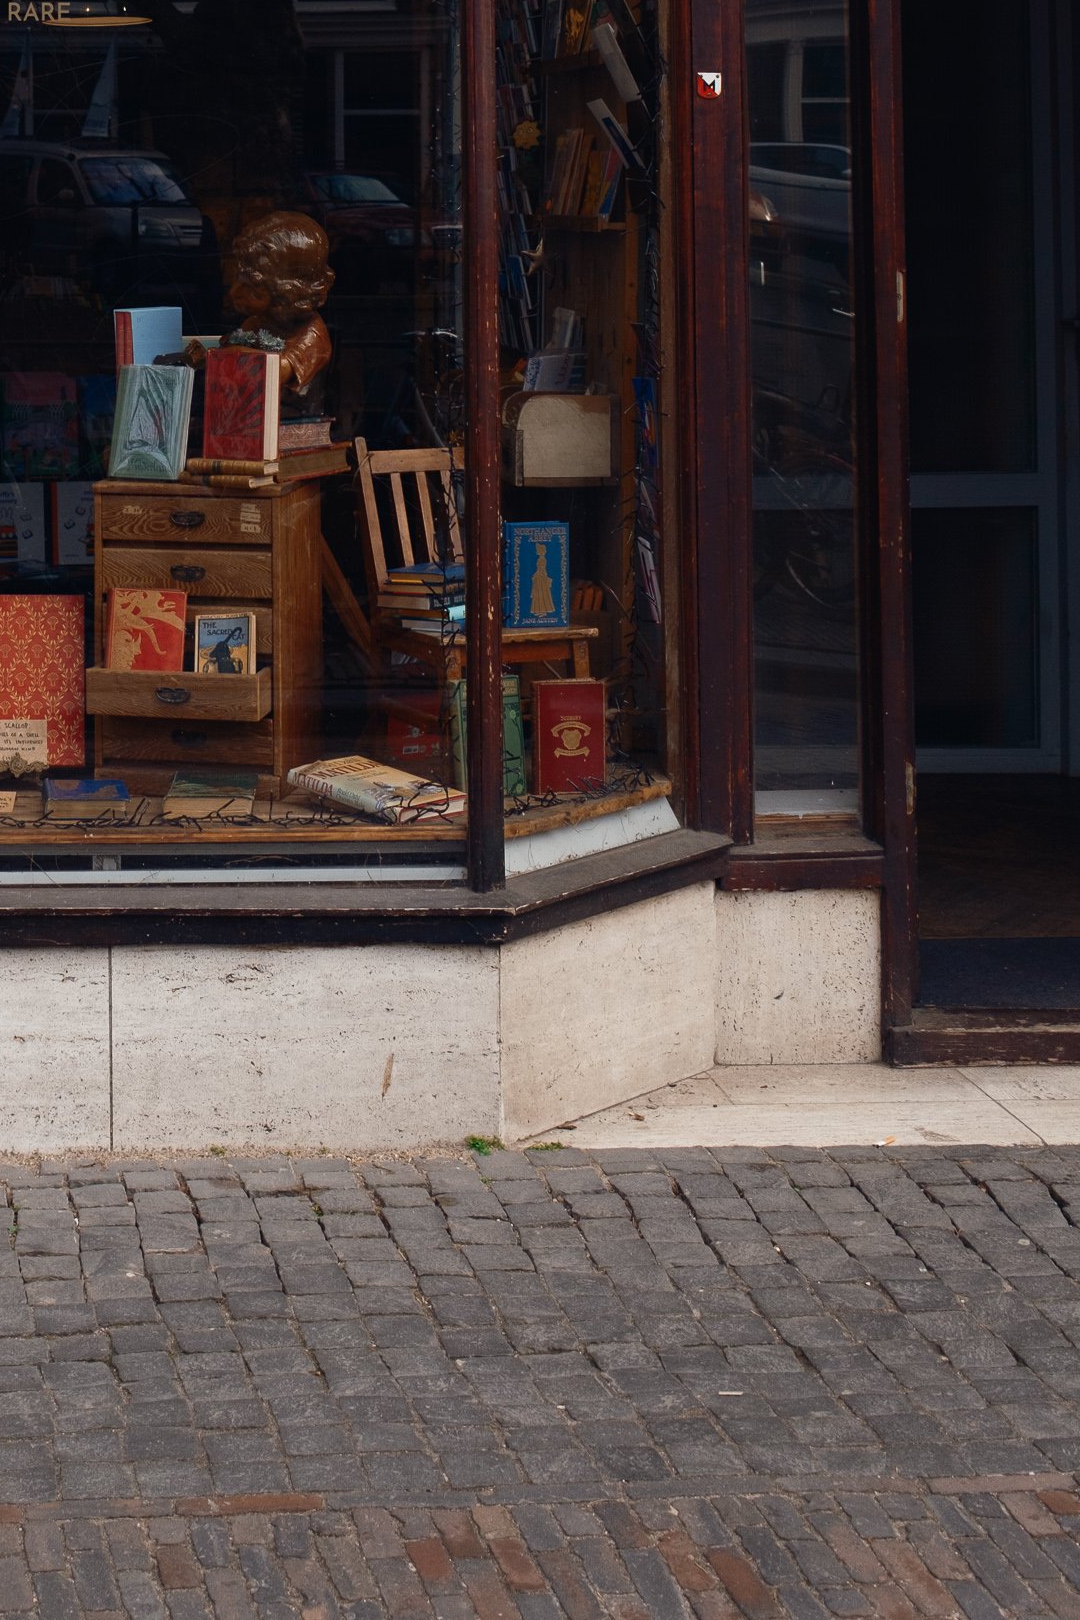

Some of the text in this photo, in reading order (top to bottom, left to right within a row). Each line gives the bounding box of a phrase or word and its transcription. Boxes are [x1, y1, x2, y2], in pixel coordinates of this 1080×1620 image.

[9, 1, 72, 21] RARE
[206, 628, 233, 636] SACRED
[311, 761, 381, 779] MATILDA
[294, 771, 333, 797] MATILDA
